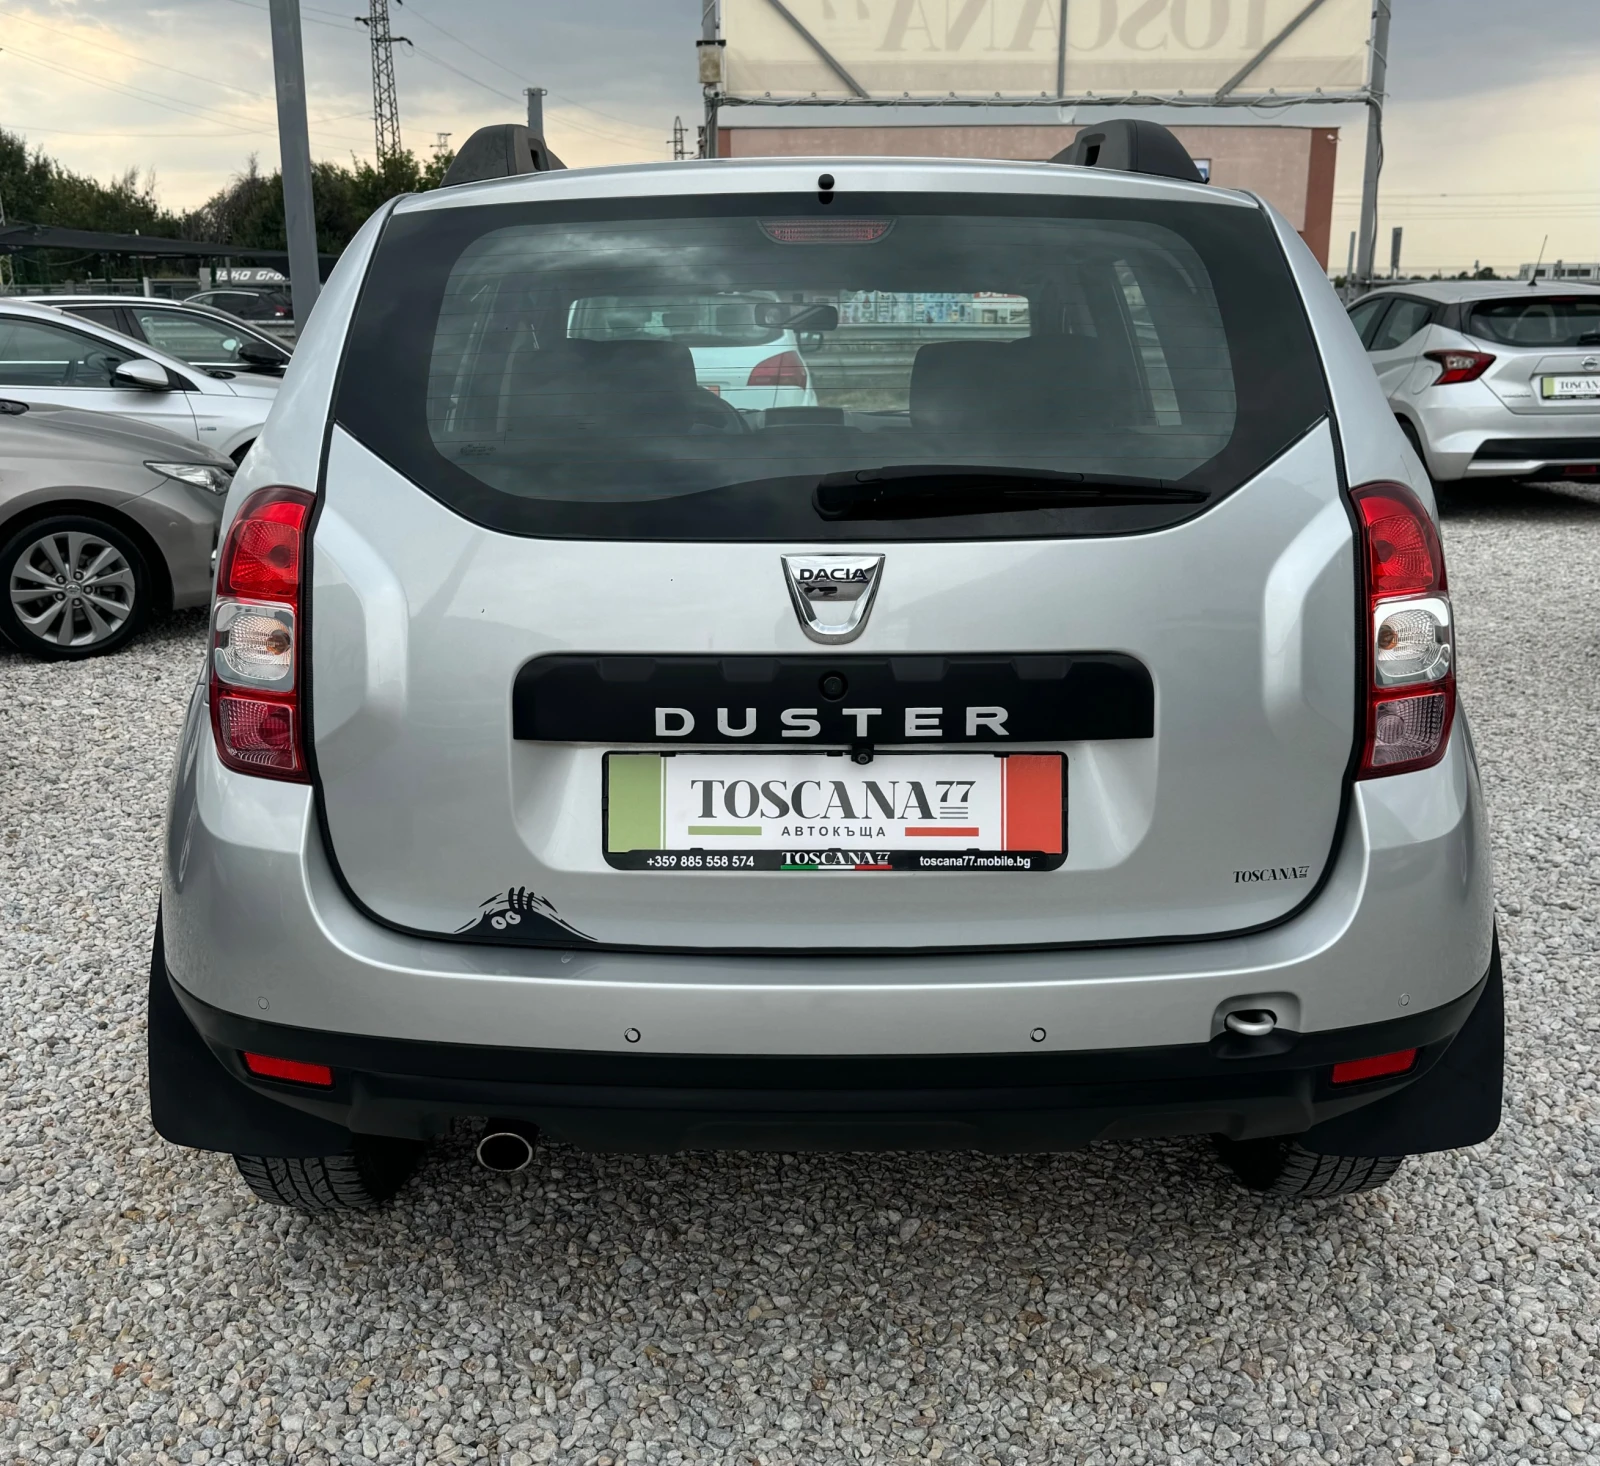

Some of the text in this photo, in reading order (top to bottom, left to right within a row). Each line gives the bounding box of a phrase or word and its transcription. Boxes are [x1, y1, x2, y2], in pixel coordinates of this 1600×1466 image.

[1560, 380, 1600, 390] TOSCAN
[799, 568, 868, 581] DACIA
[655, 706, 1010, 738] DUSTER
[781, 826, 886, 839] АВТОКЪЩА
[646, 855, 755, 868] +359 885 558 574
[919, 855, 1031, 869] toscana77.mobile.bg
